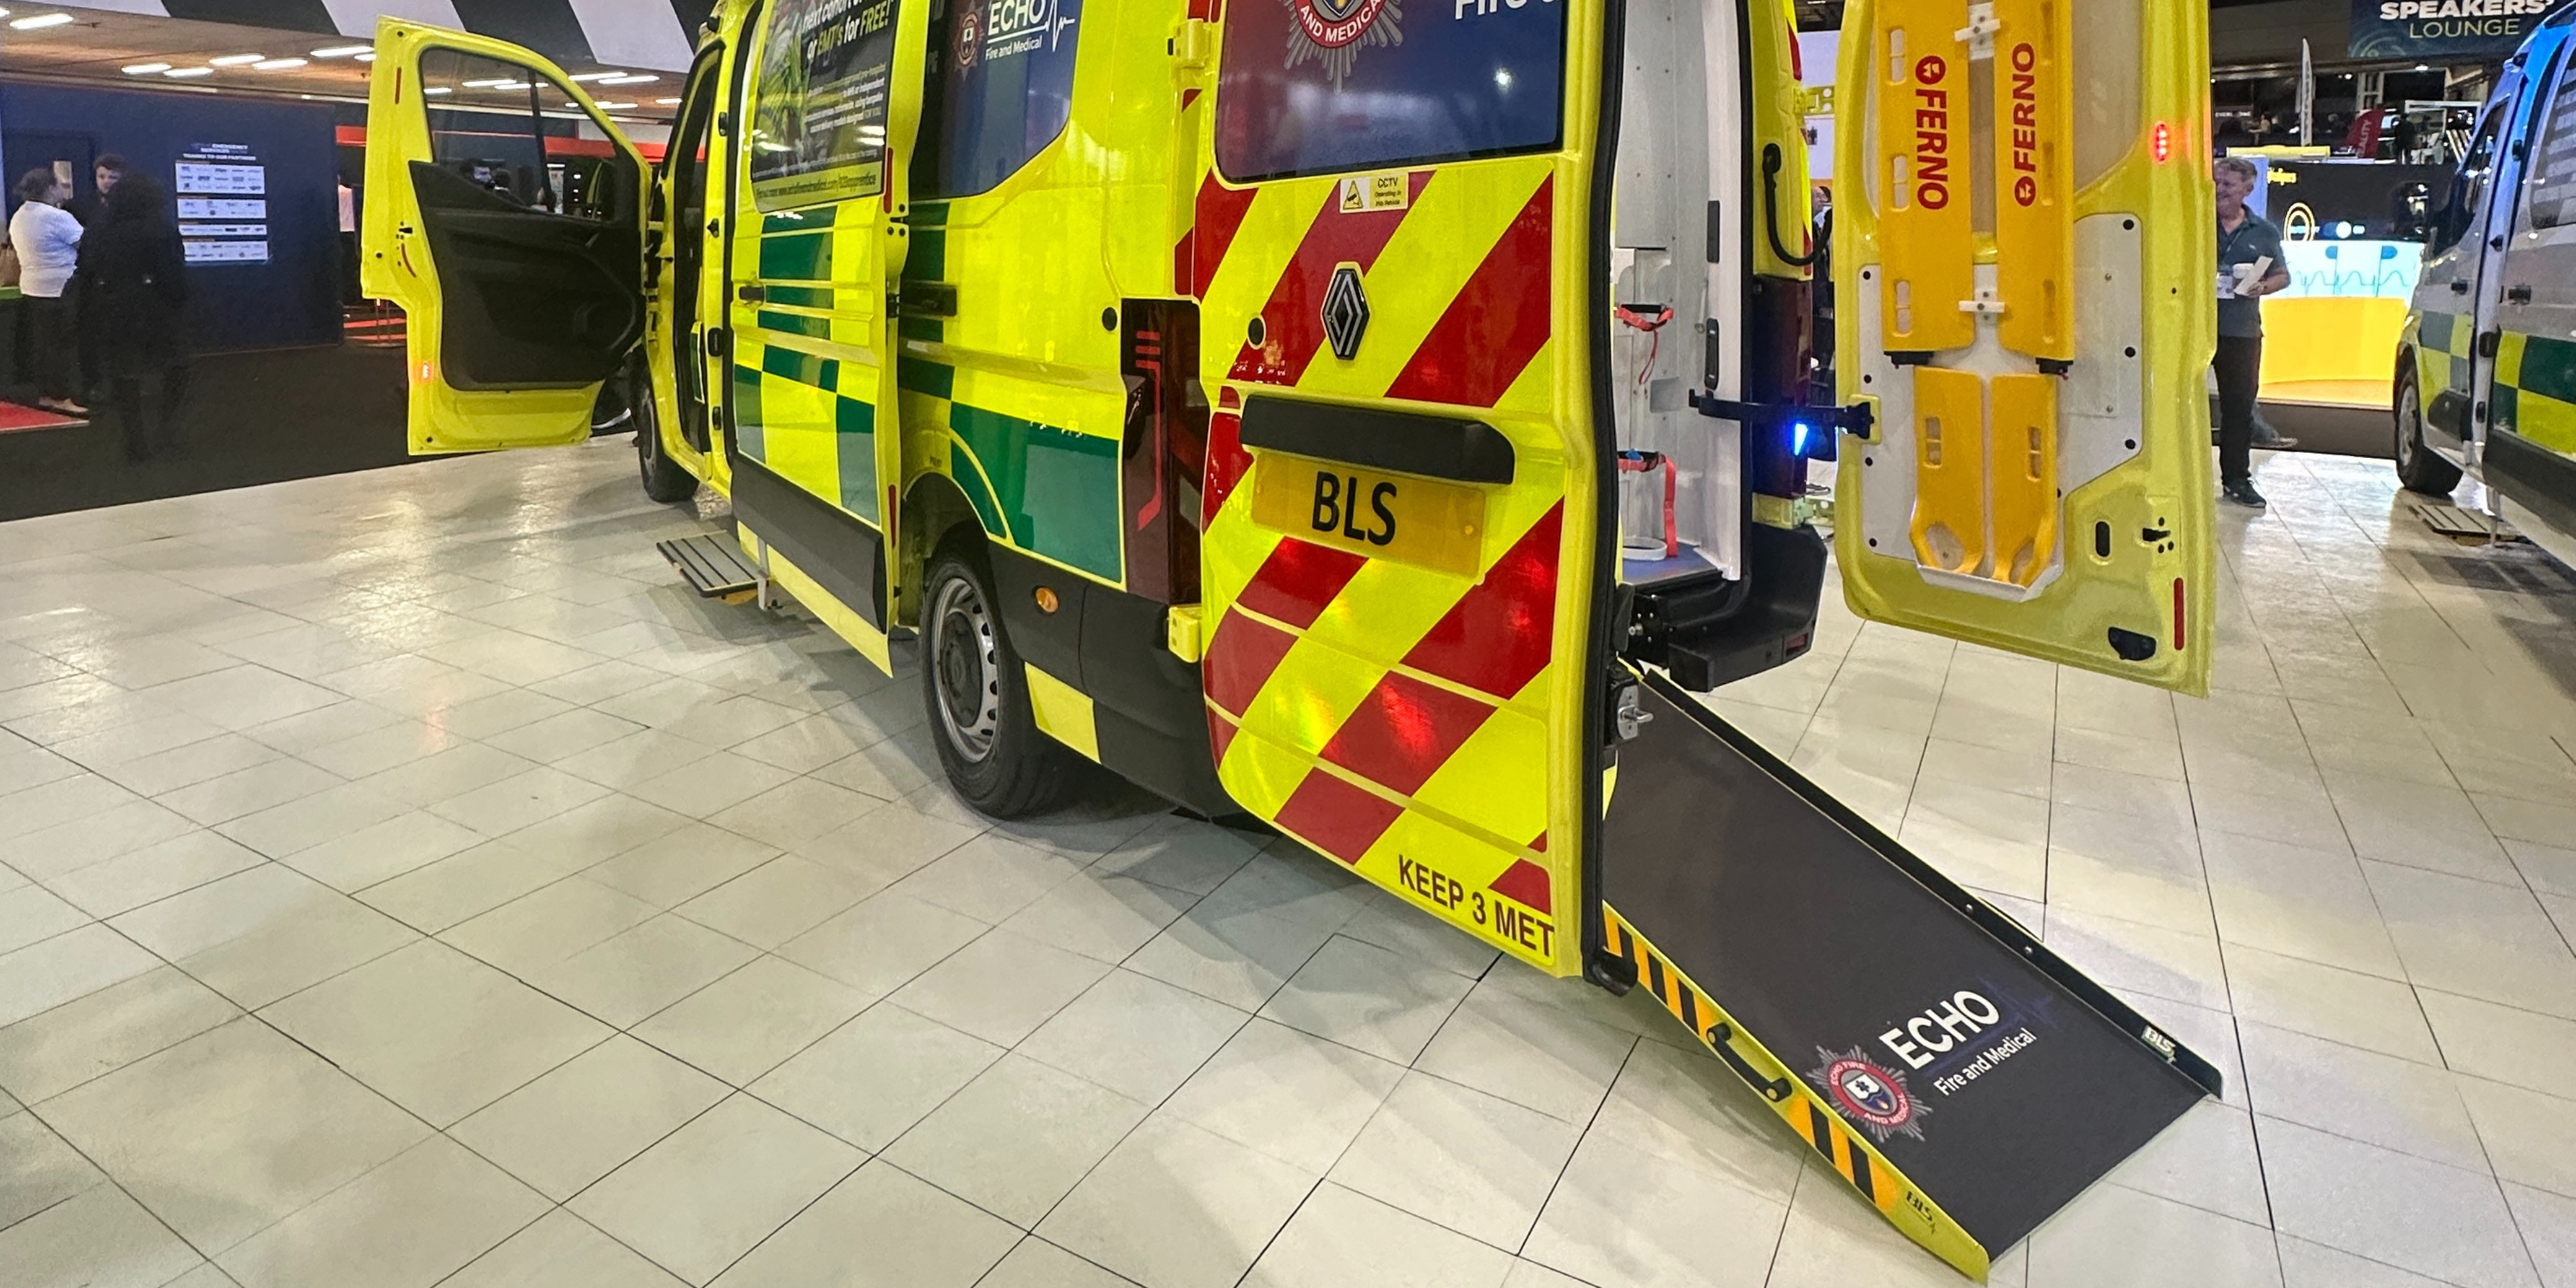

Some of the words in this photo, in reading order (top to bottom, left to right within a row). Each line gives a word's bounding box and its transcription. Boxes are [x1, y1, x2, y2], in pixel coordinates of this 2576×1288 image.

[807, 39, 818, 60] or
[844, 15, 860, 44] for
[987, 0, 1046, 36] ECHO
[1300, 5, 1323, 37] AND
[2410, 18, 2521, 39] LOUNGE
[985, 47, 998, 61] Fire
[999, 44, 1012, 58] and
[1013, 35, 1042, 55] Medical
[2012, 42, 2038, 173] FERNO
[1915, 90, 1949, 211] FERNO
[1378, 177, 1399, 188] CCTV
[1311, 470, 1398, 546] BLS
[1398, 854, 1464, 911] KEEP
[1472, 891, 1486, 925] 3
[1495, 900, 1555, 958] MET
[1879, 990, 2000, 1070] ECHO
[1830, 1065, 1843, 1086] ECHO
[1933, 1074, 1967, 1096] Fire
[1962, 1055, 1993, 1080] and
[1983, 1027, 2038, 1065] Medical
[1864, 1112, 1889, 1124] AND
